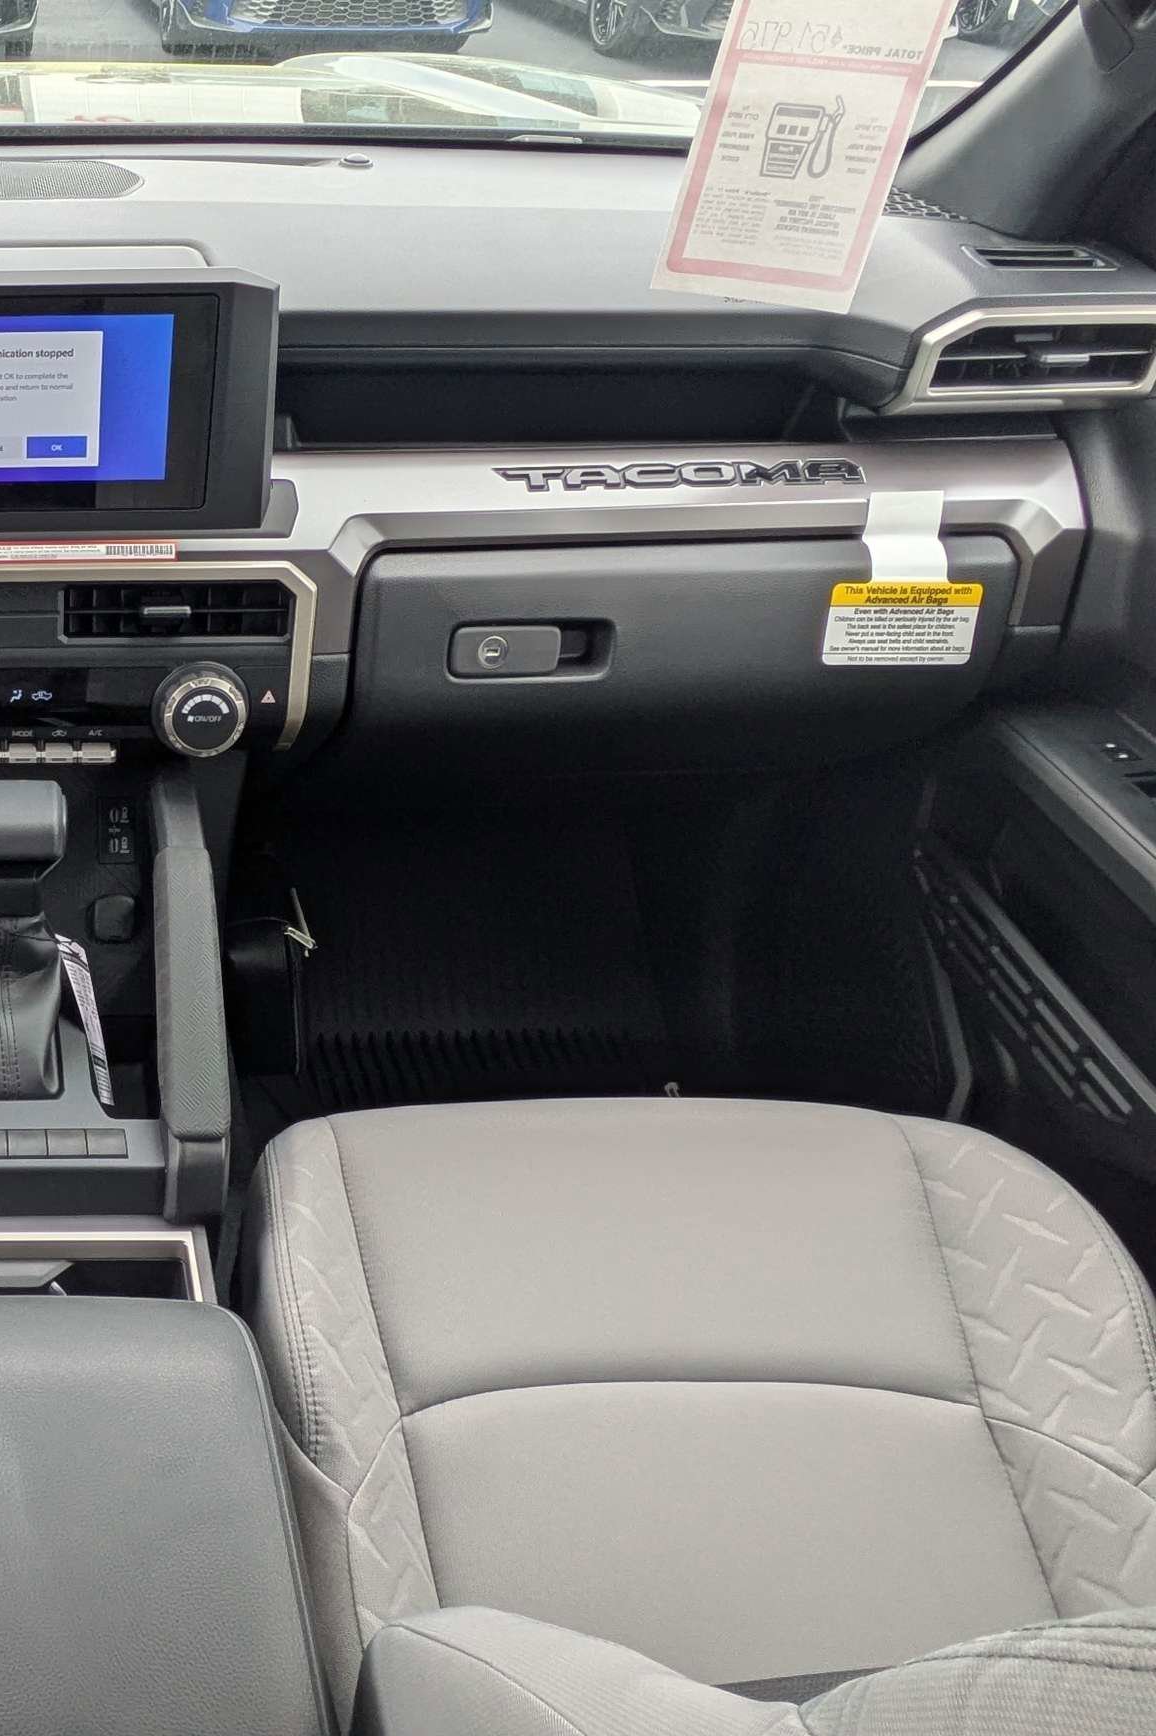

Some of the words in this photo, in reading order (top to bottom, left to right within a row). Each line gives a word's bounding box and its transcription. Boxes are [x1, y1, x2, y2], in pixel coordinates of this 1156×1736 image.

[35, 348, 75, 360] stopped
[24, 373, 55, 381] complete
[491, 458, 866, 492] TACOMA
[845, 586, 864, 594] This
[866, 586, 898, 594] Vehicle
[910, 586, 952, 596] Equipped
[954, 586, 973, 594] with
[864, 595, 909, 604] Advanced
[910, 595, 924, 604] Air
[925, 595, 948, 606] Bags
[937, 608, 955, 616] Bags
[88, 729, 103, 737] A/C
